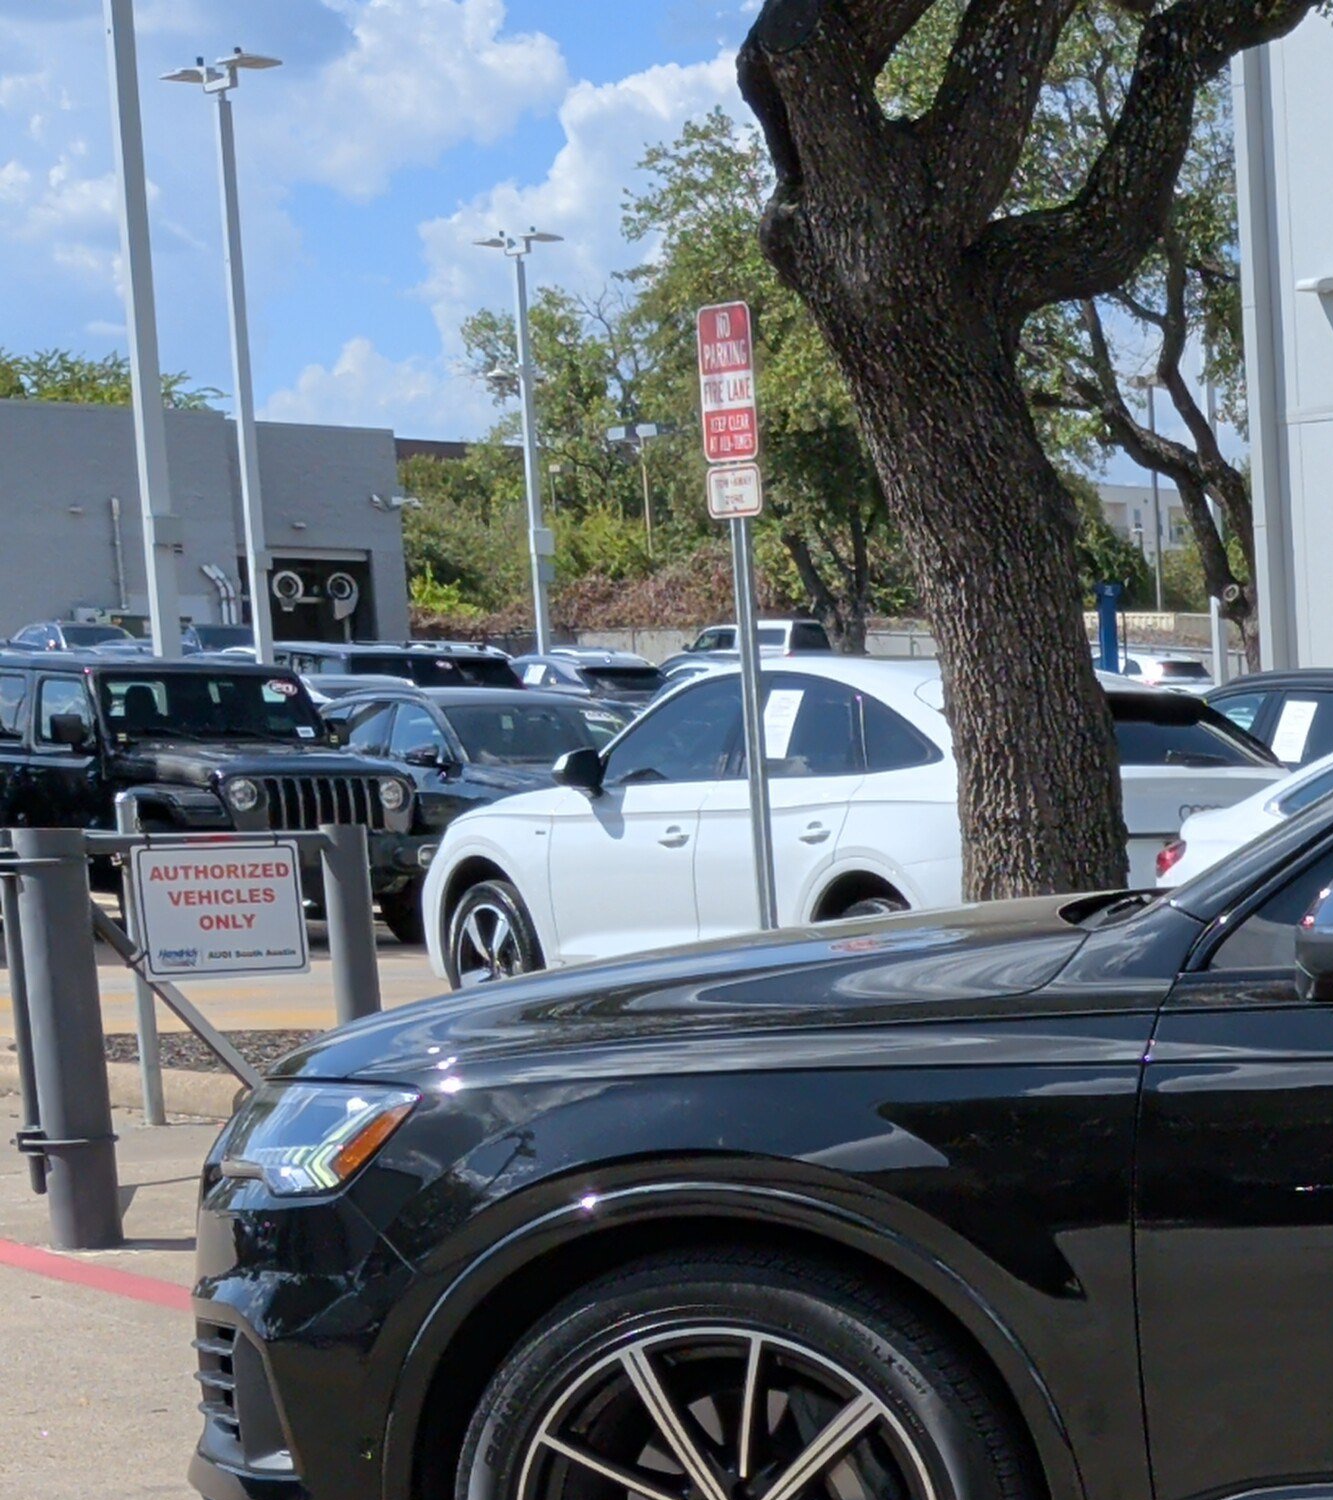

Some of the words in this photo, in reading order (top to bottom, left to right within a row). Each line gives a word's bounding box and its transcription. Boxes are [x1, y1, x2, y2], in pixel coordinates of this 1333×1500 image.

[715, 311, 731, 339] NO
[703, 340, 747, 370] PARKING
[704, 380, 724, 405] FIRE
[727, 377, 751, 402] LANE
[710, 416, 727, 433] KEEP
[728, 413, 750, 431] CLEAR
[150, 862, 289, 881] AUTHORIZED
[168, 888, 275, 906] VEHICLES
[200, 914, 256, 931] ONLY
